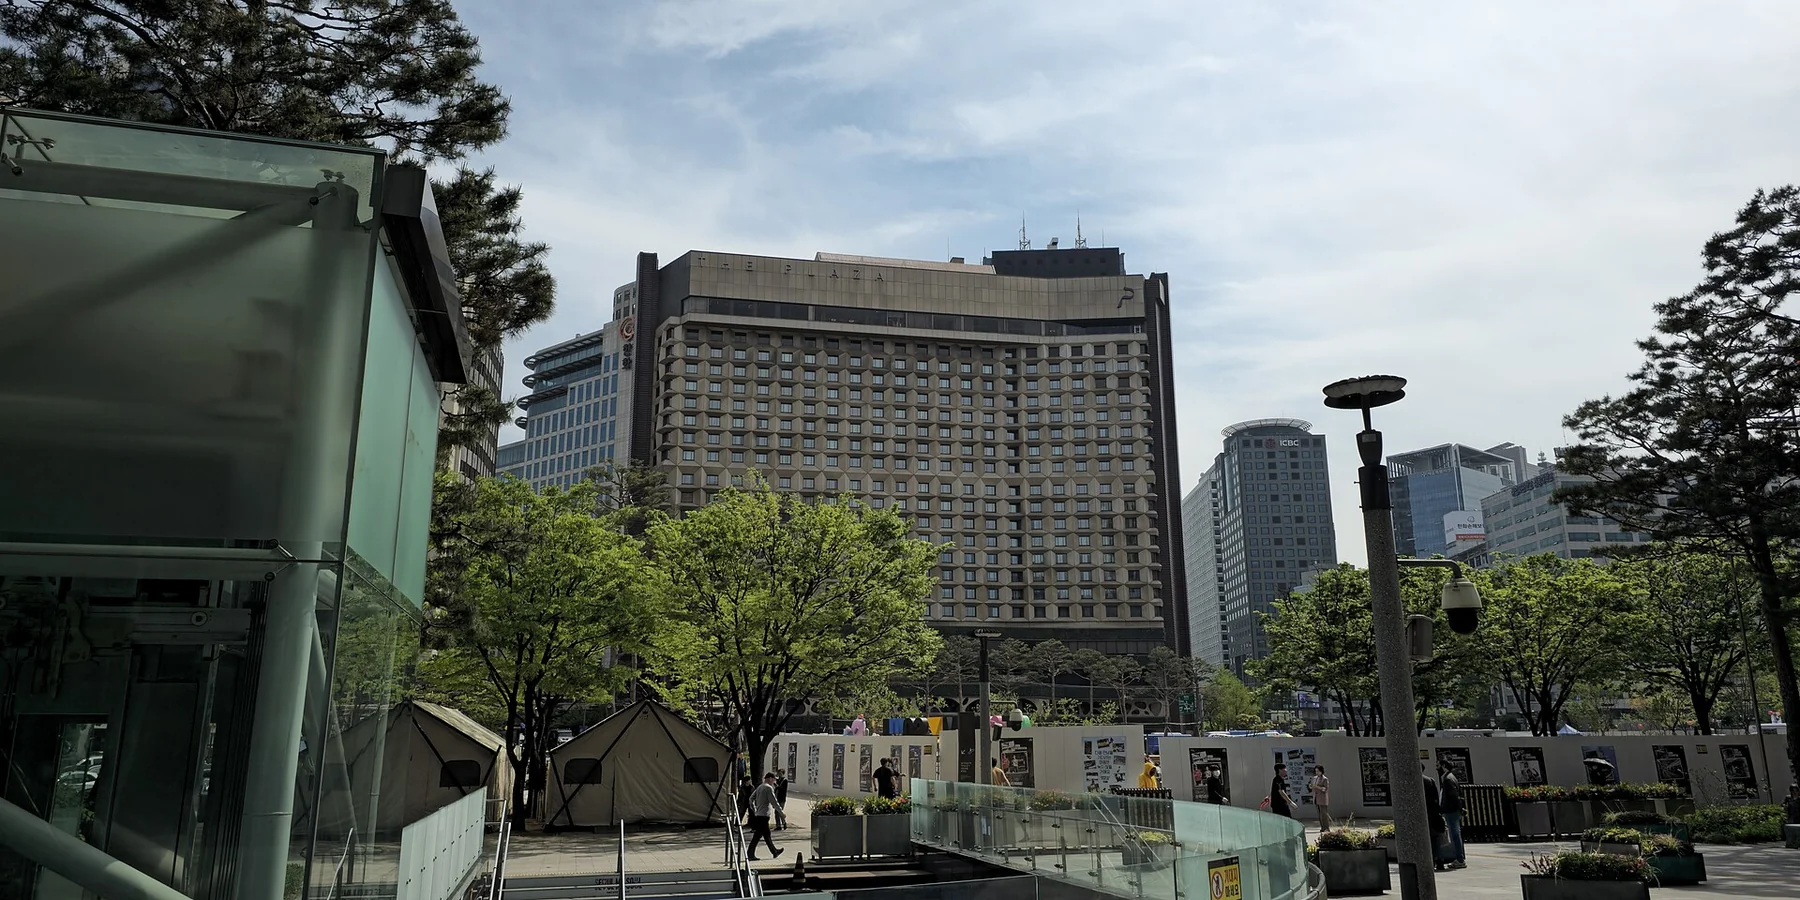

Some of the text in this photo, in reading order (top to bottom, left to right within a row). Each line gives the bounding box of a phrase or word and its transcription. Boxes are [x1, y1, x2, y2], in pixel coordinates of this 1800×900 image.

[698, 255, 884, 283] THE PLAZA
[622, 342, 633, 370] 한화
[1279, 439, 1300, 447] ICBC
